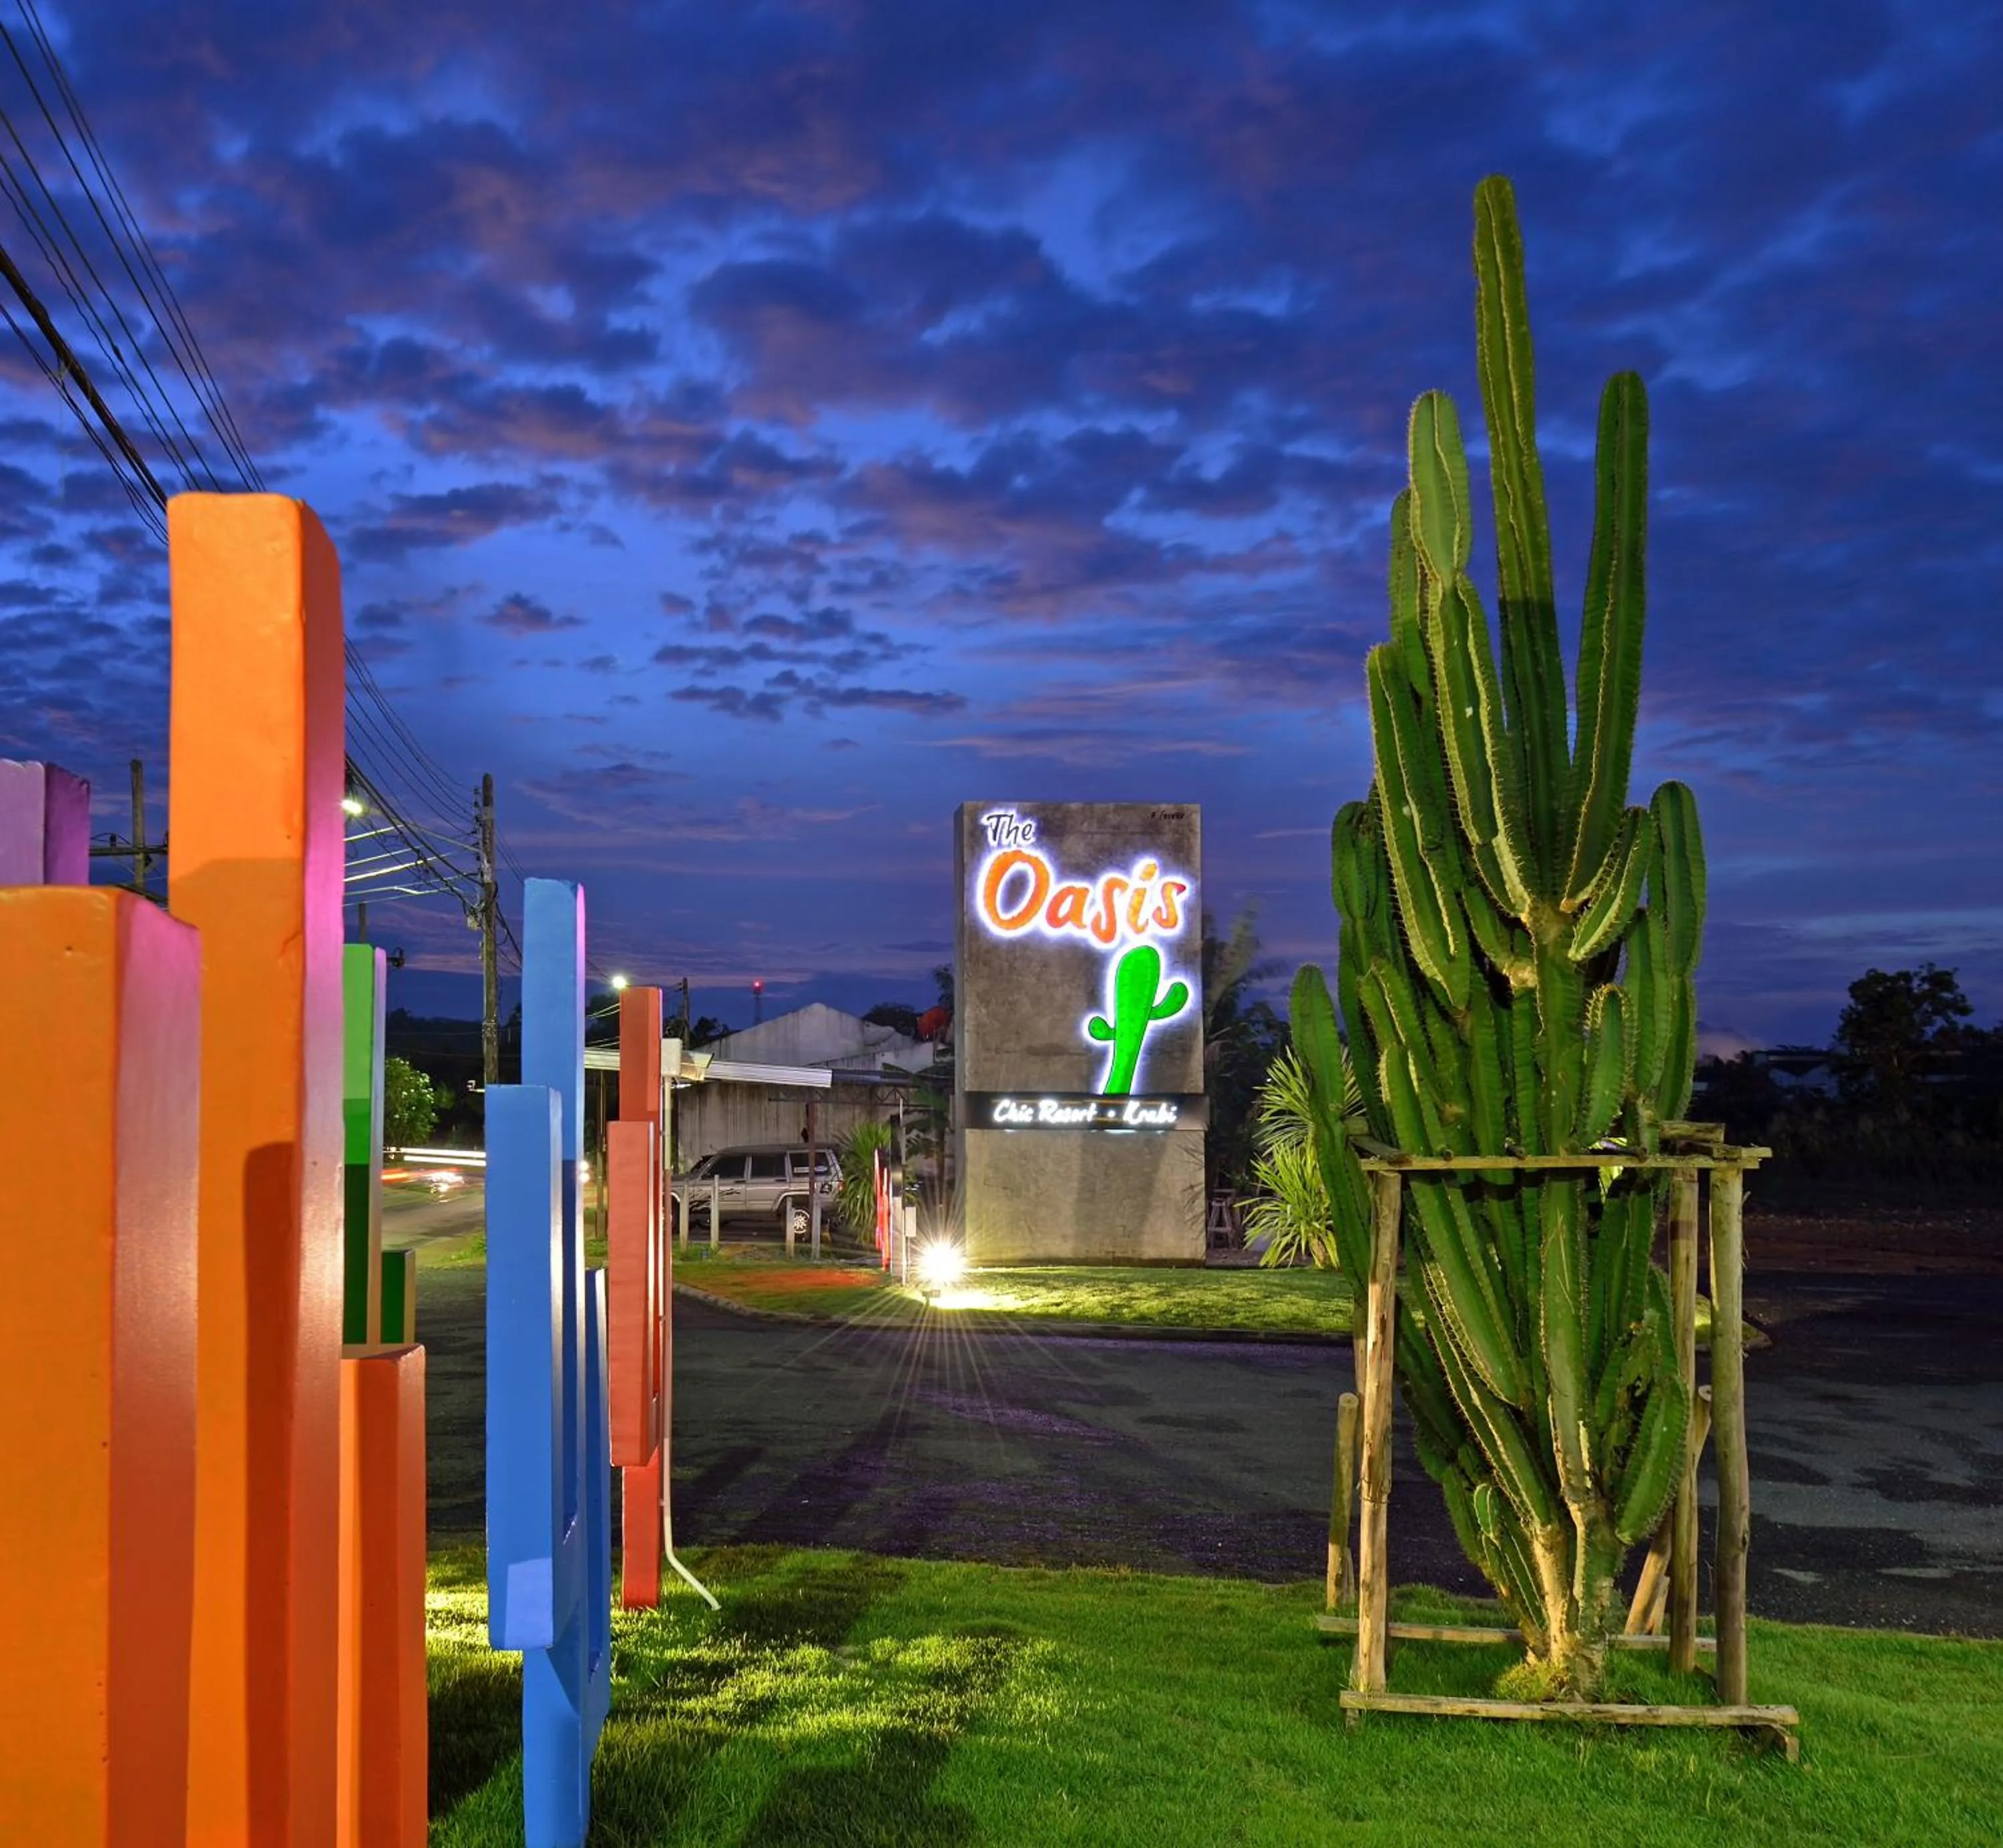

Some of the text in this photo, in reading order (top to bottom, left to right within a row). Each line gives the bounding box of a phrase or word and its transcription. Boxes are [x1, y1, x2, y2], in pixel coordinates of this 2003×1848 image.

[985, 813, 1034, 845] The
[983, 849, 1186, 944] Oasis
[993, 1099, 1034, 1122] Chic
